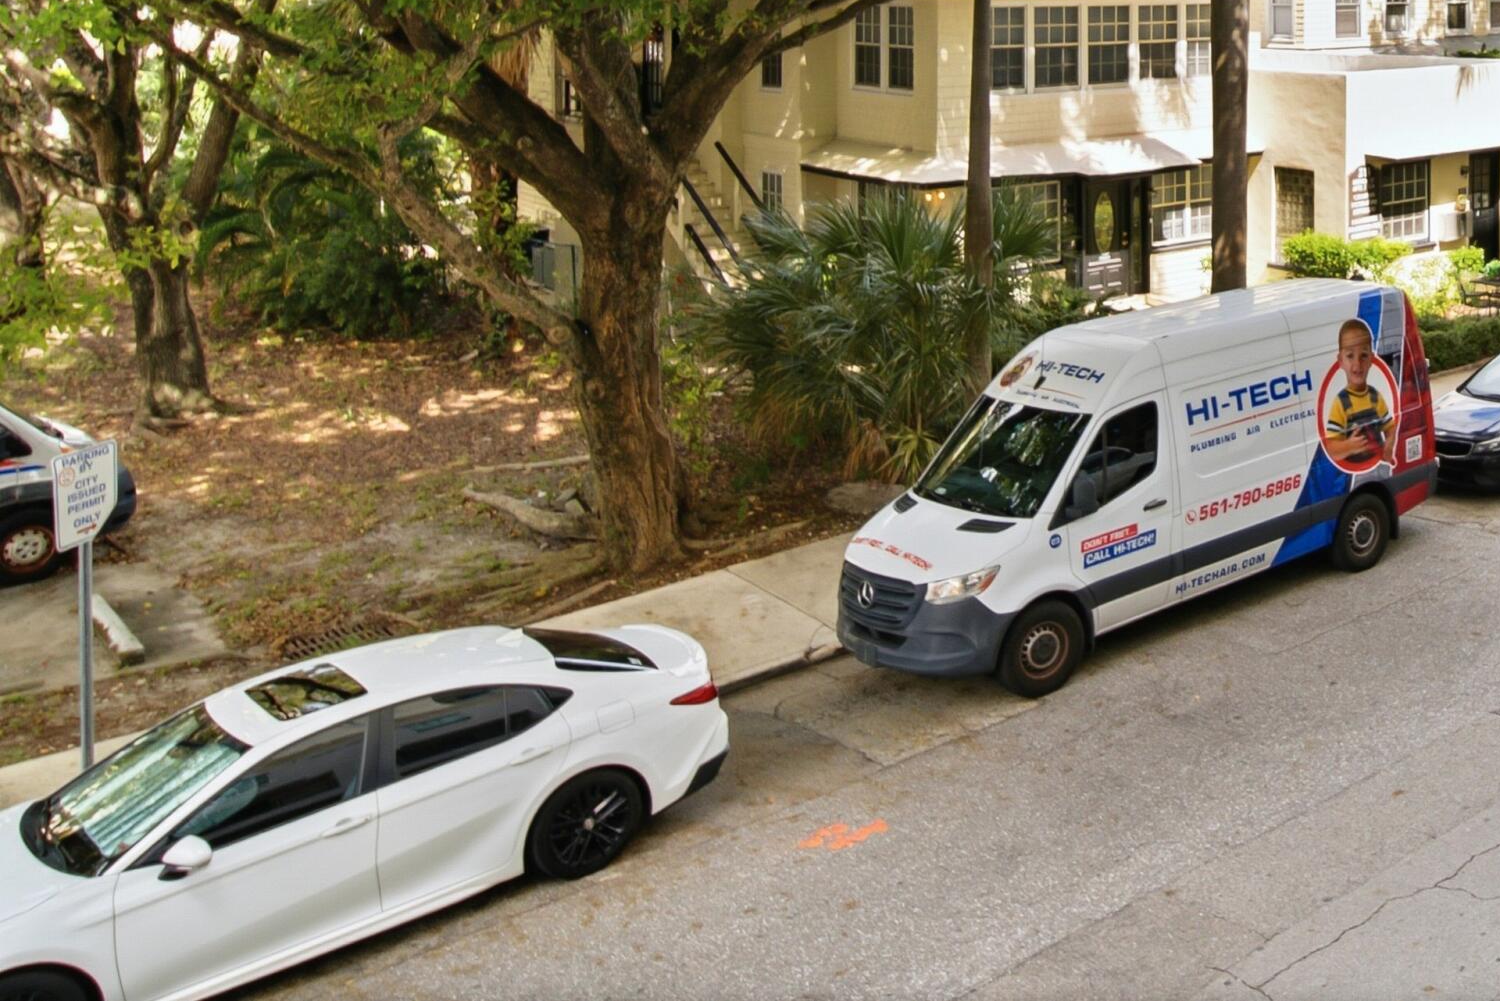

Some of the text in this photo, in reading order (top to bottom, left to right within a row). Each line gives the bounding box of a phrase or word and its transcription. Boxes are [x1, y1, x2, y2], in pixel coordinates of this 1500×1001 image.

[1035, 360, 1105, 383] HI-TECH
[1186, 370, 1312, 426] HI-TECH
[1190, 408, 1316, 453] PLUMBING AIR ELECTRICAL
[62, 446, 110, 467] PARKING
[79, 460, 93, 473] BY
[75, 475, 98, 489] CITY
[67, 483, 106, 503] ISSUED
[1199, 474, 1301, 521] 561-790-6966
[67, 494, 106, 514] PERMIT
[73, 511, 102, 528] ONLY
[1083, 534, 1109, 550] DON'T
[1086, 533, 1155, 565] CALL HI-TECH!
[1176, 553, 1266, 594] HI-TECHAIR.COM
